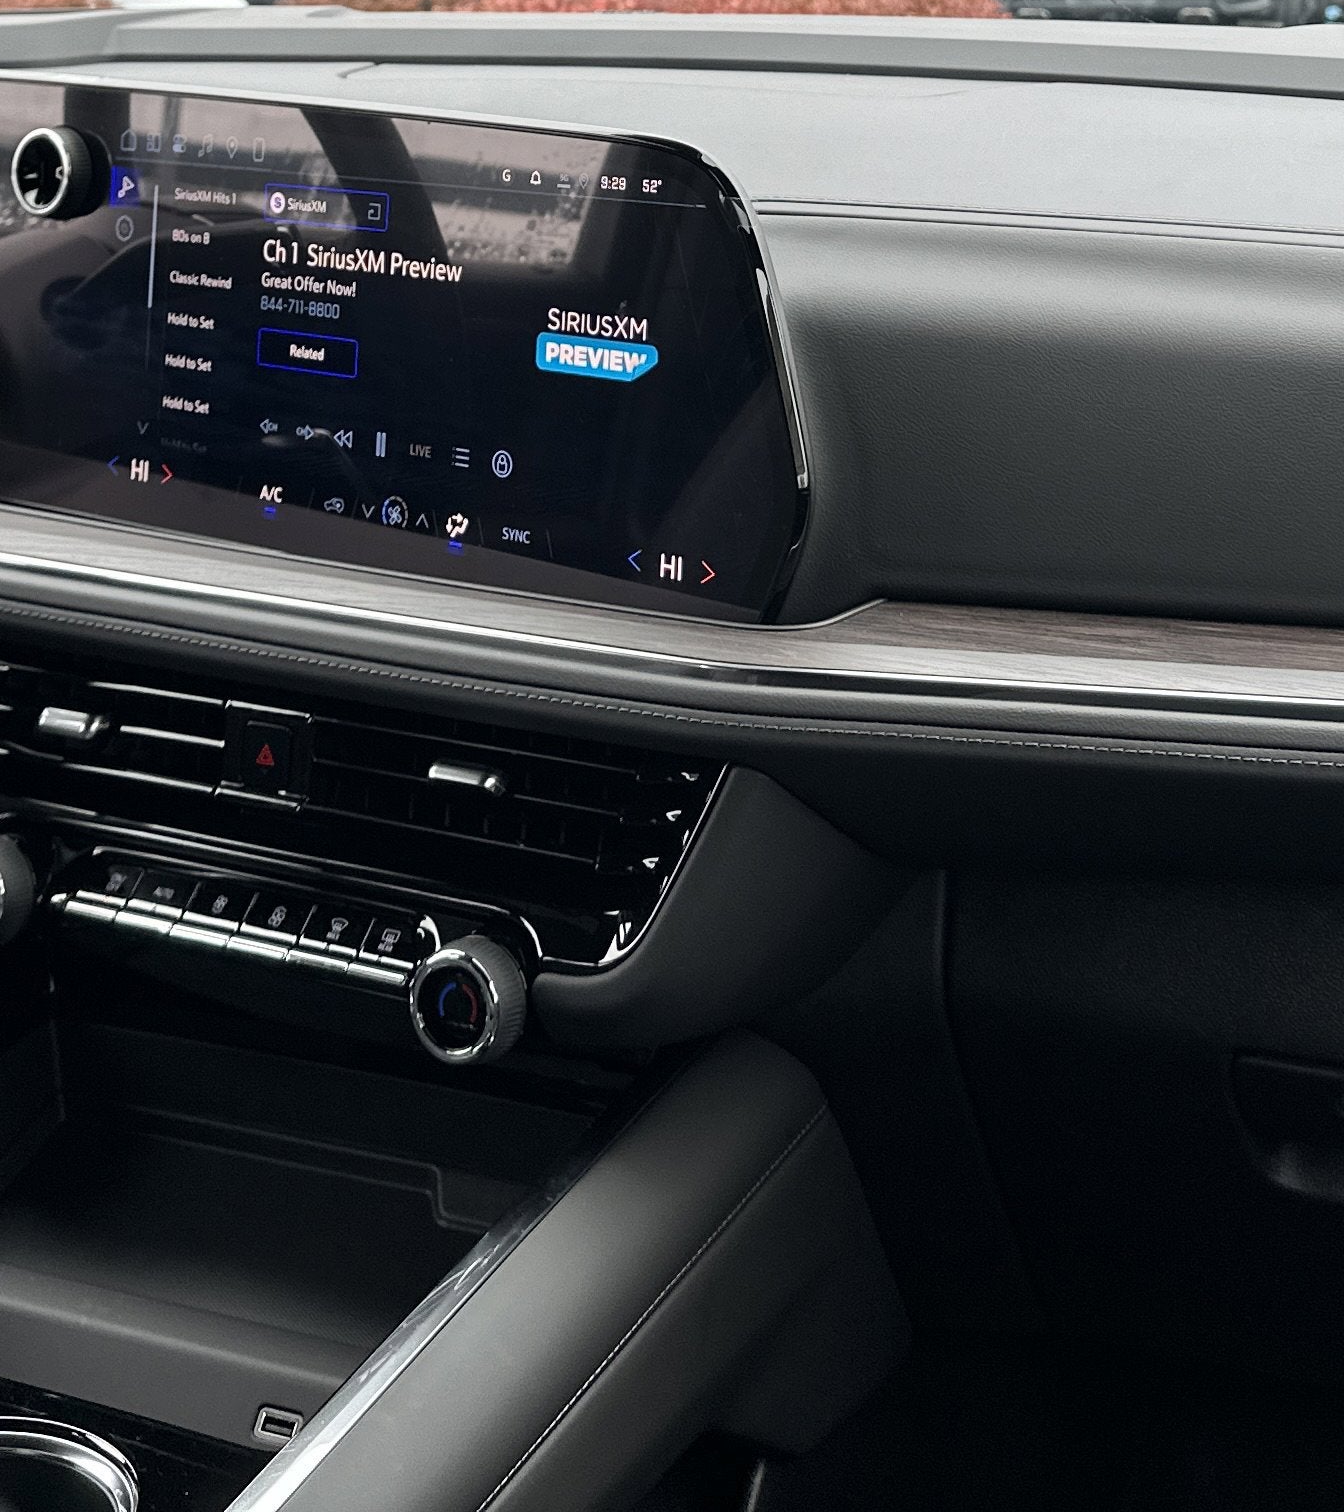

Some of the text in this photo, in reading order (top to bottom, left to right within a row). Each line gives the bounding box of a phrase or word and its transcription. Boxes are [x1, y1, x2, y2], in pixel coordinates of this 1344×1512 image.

[600, 175, 627, 191] 9:29
[642, 179, 662, 193] 52°
[174, 188, 212, 203] SiriusXM
[212, 190, 231, 205] Hits
[286, 197, 328, 214] SiriusXM
[190, 233, 202, 245] on
[262, 238, 463, 283] Ch 1 SiriusXM Preview
[169, 270, 233, 291] Classic Rewind
[260, 272, 357, 298] Great Offer Now!
[259, 295, 341, 320] 844-711-8800
[166, 312, 215, 330] Hold to Set
[547, 307, 648, 342] SIRIUSXM
[164, 353, 212, 373] Hold to Set
[288, 343, 325, 363] Related
[545, 341, 648, 374] PREVIEW
[161, 395, 211, 415] Hold to Set
[409, 443, 432, 459] LIVE
[129, 458, 150, 483] HI
[259, 484, 284, 504] A/C
[502, 527, 531, 545] SYNC
[659, 553, 683, 582] HI
